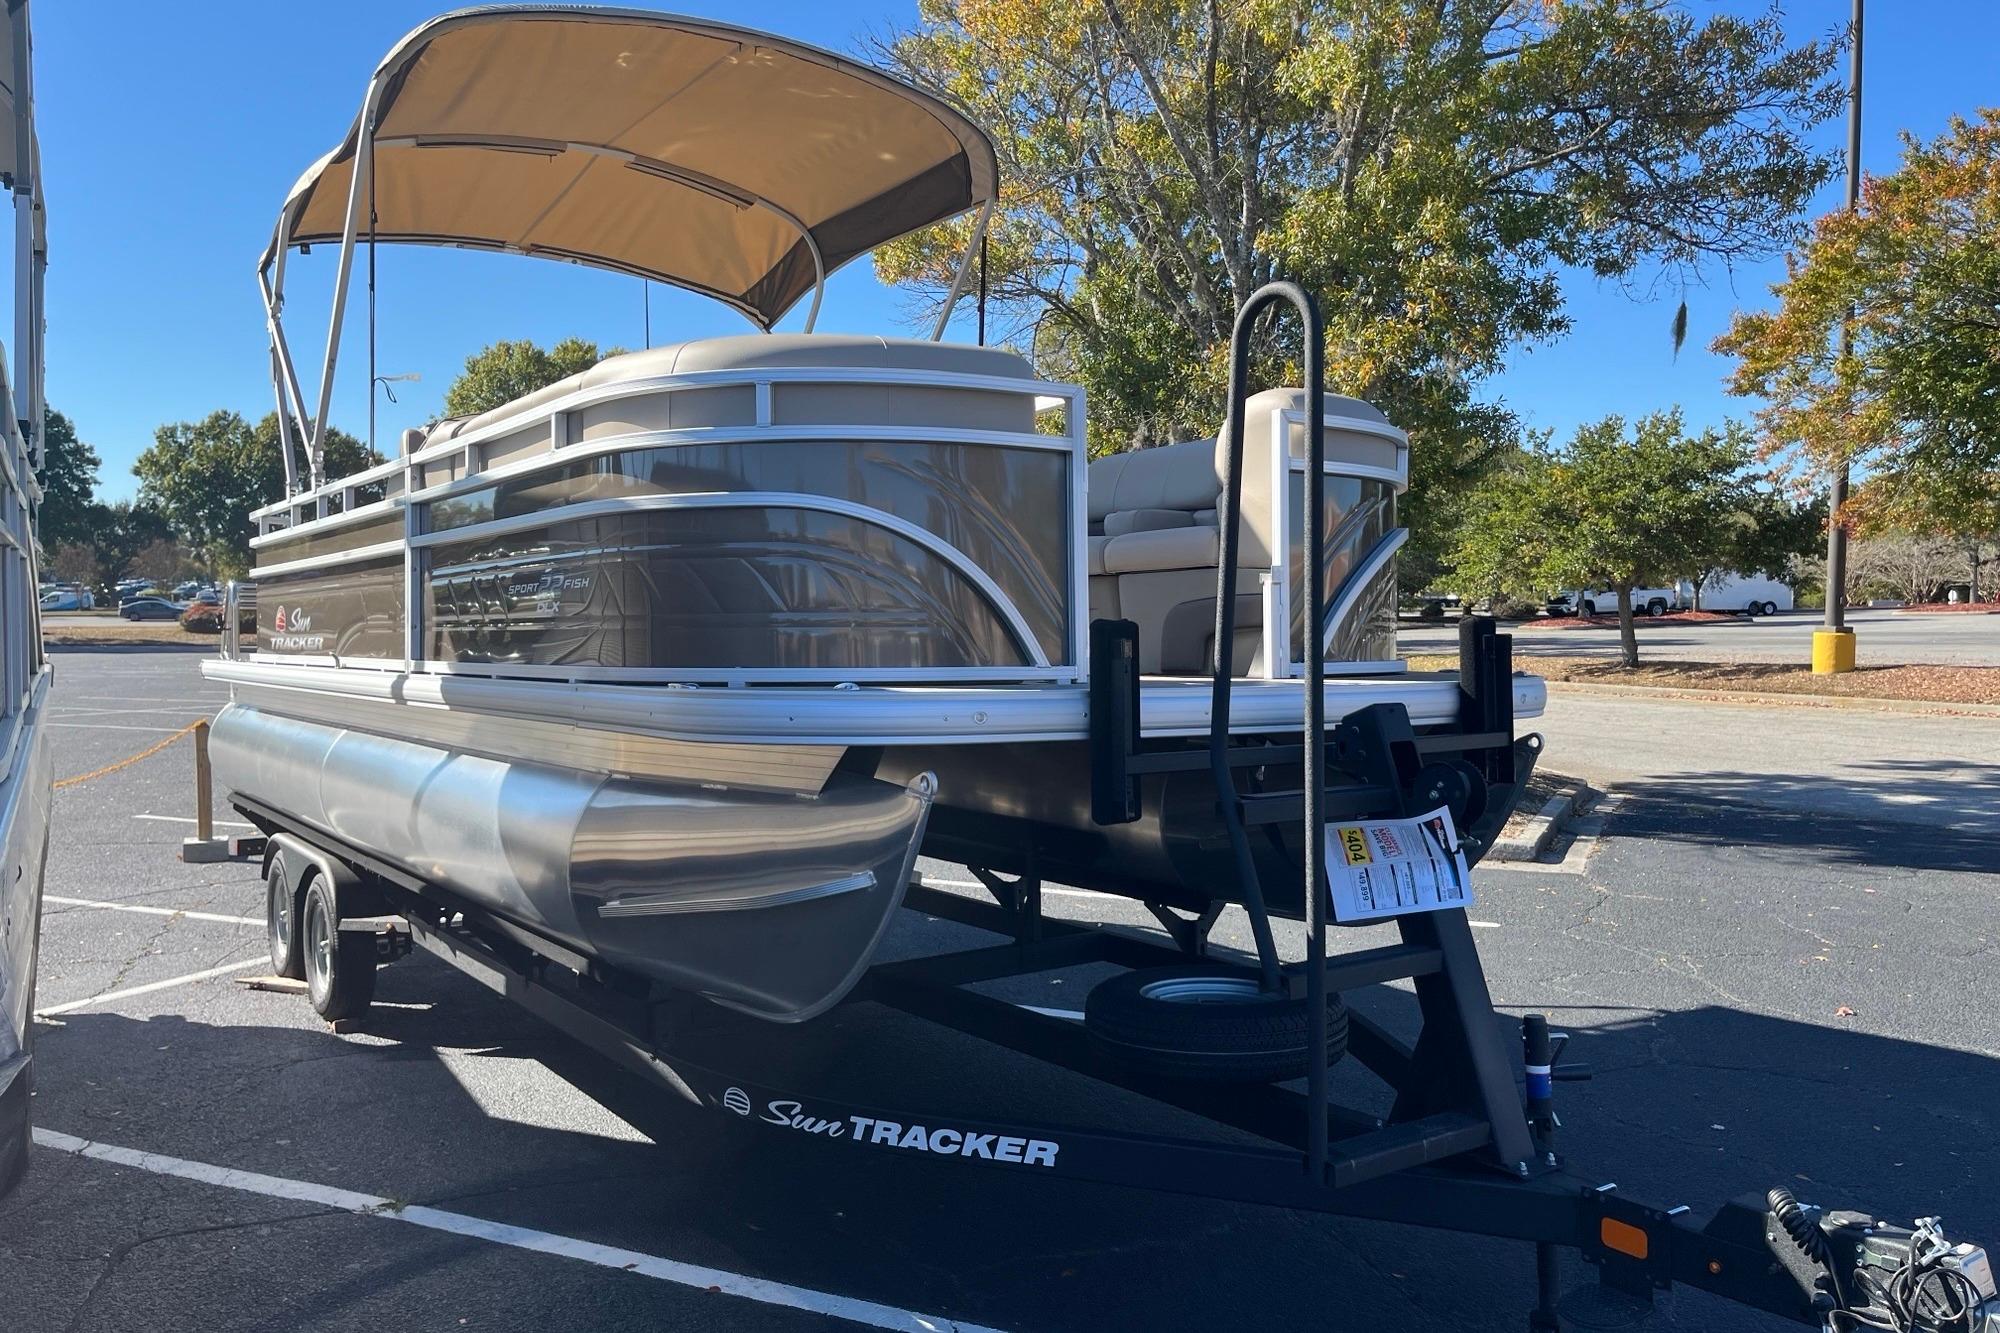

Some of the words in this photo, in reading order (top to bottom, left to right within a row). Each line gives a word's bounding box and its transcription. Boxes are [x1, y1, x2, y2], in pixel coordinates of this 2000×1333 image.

[508, 582, 540, 595] SPORT
[563, 577, 590, 590] FISH
[536, 601, 560, 613] DLX
[288, 607, 311, 632] Sun
[270, 636, 324, 650] TRACKER
[1347, 830, 1366, 862] $404
[1370, 829, 1383, 845] SAVE
[759, 1100, 845, 1137] Sun
[850, 1115, 1060, 1167] TRACKER
